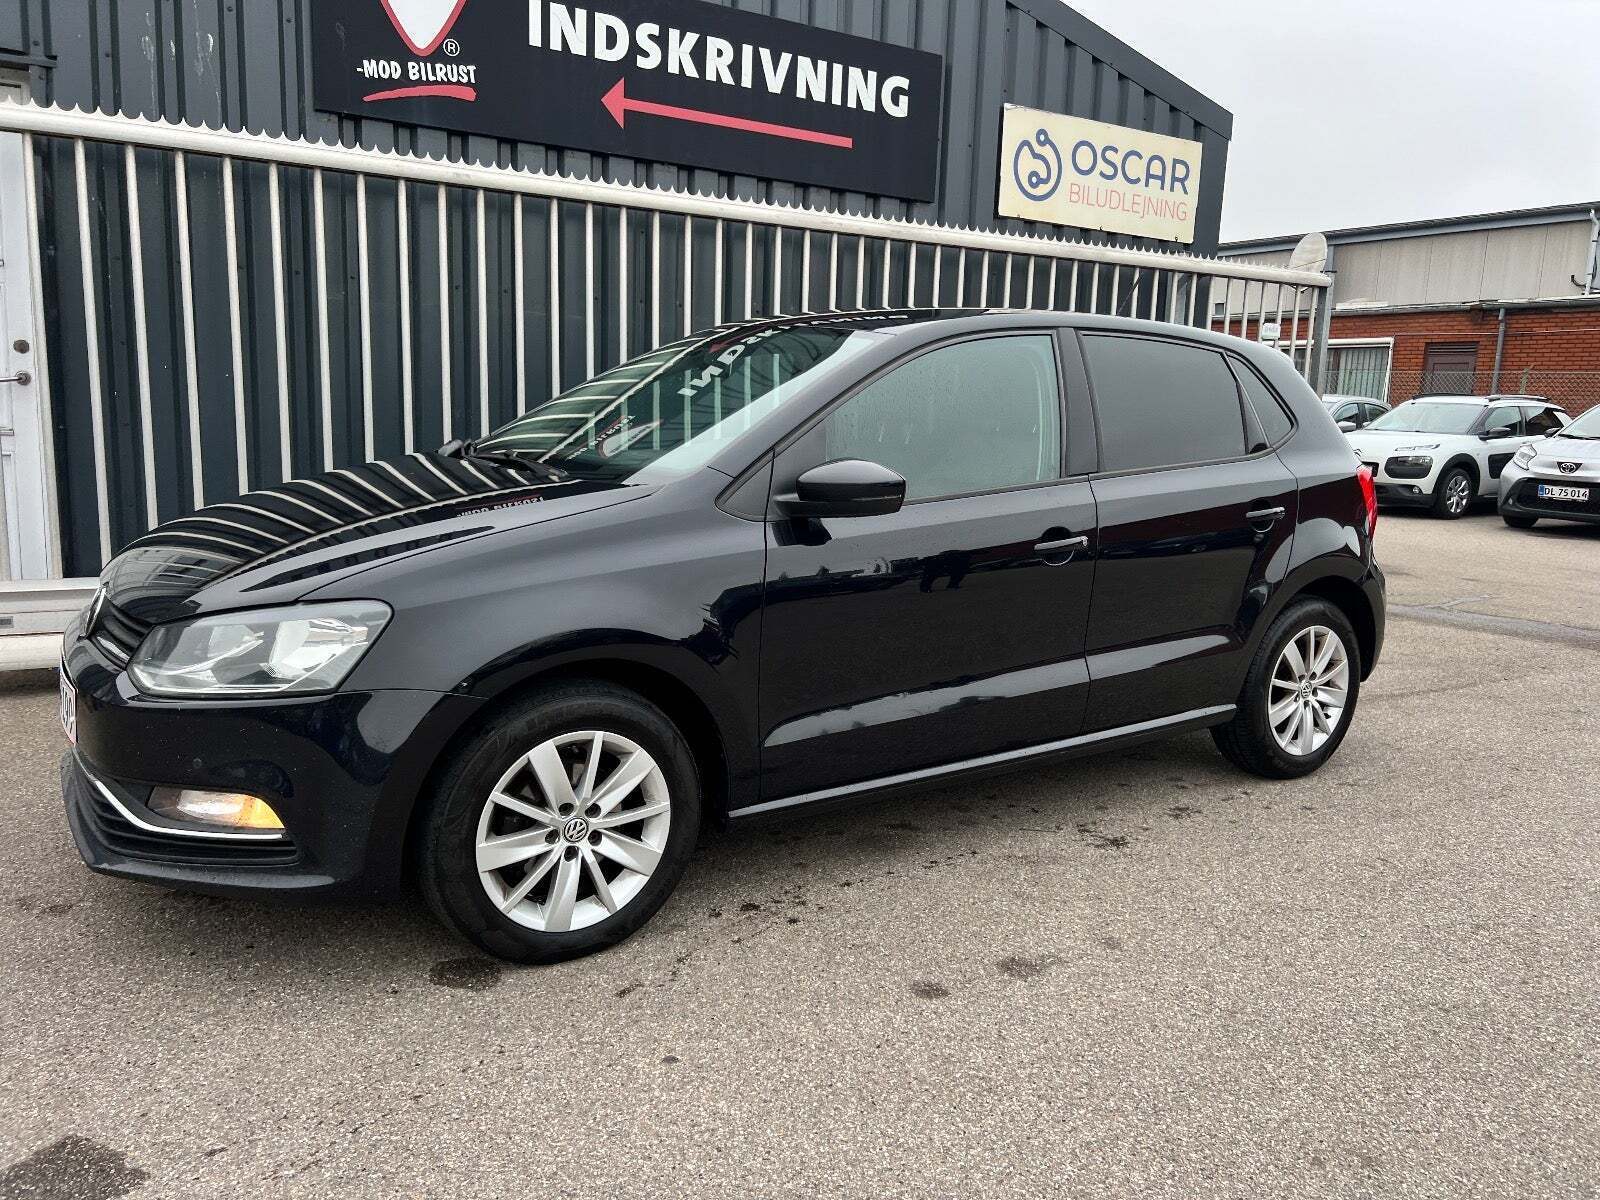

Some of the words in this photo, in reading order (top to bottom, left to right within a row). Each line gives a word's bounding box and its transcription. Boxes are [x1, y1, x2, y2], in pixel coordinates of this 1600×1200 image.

[356, 59, 402, 80] -MOD
[407, 61, 477, 84] BILRUST
[528, 0, 911, 118] INDSKRIVNING
[1071, 140, 1191, 195] OSCAR
[1069, 183, 1188, 221] BILUDLEJNING
[1544, 487, 1556, 496] DL
[1558, 488, 1569, 497] 75
